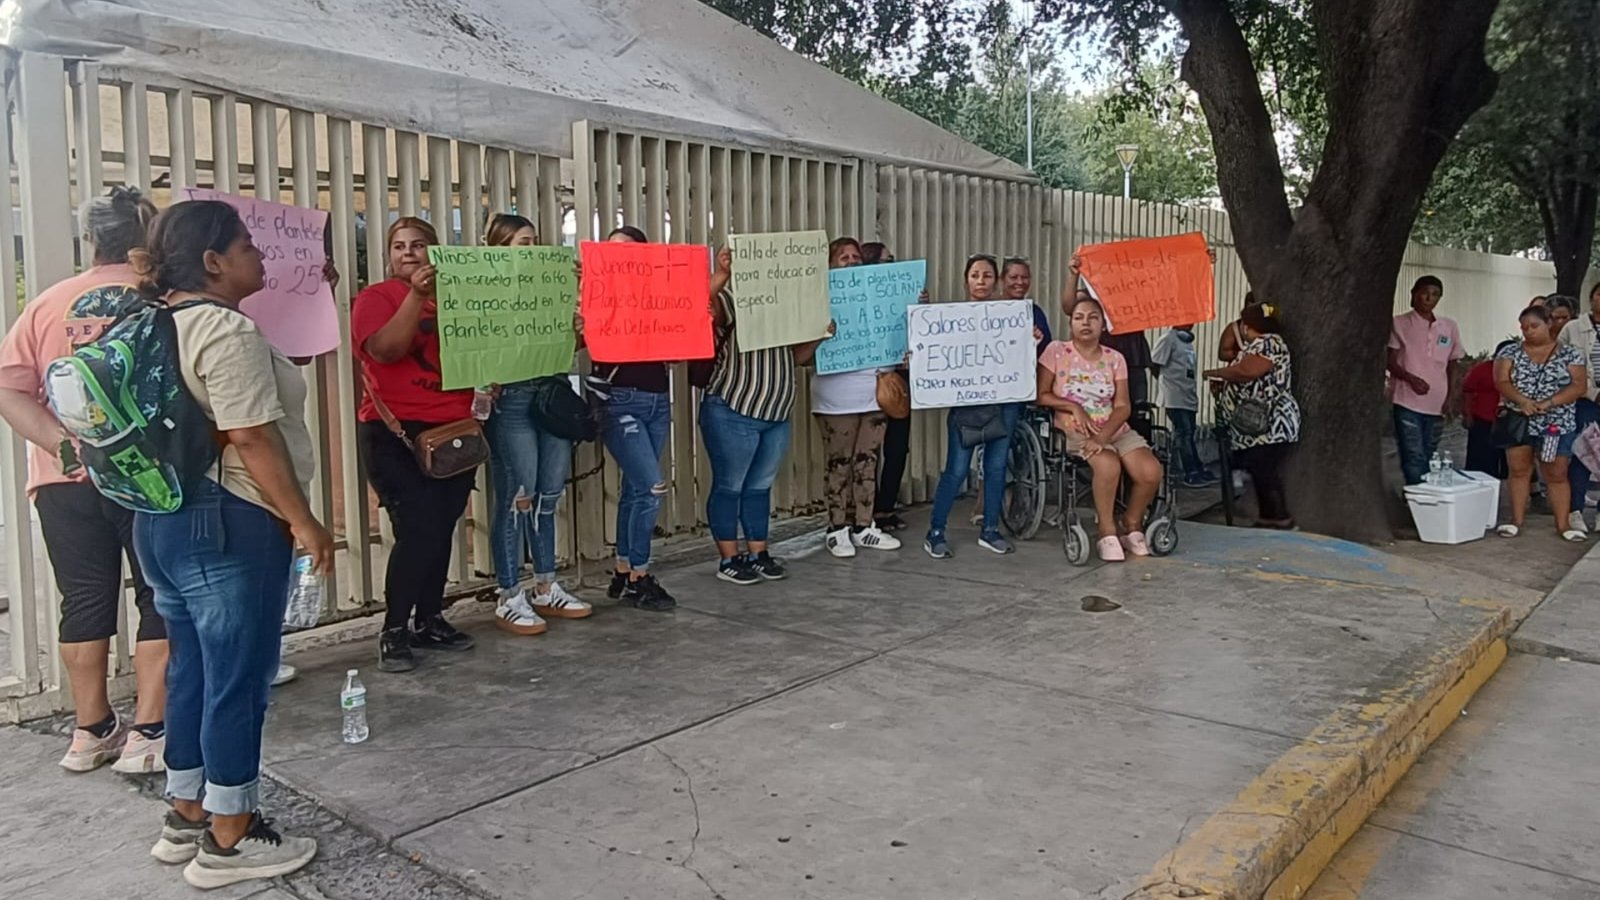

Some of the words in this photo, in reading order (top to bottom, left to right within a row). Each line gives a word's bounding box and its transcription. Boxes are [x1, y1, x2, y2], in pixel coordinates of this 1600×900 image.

[294, 246, 313, 261] en
[765, 240, 779, 259] de
[483, 251, 512, 273] que
[286, 264, 321, 296] 25
[518, 273, 535, 290] por
[734, 269, 760, 291] para
[443, 293, 459, 311] de
[465, 294, 539, 317] capacidad
[443, 317, 509, 348] planteles
